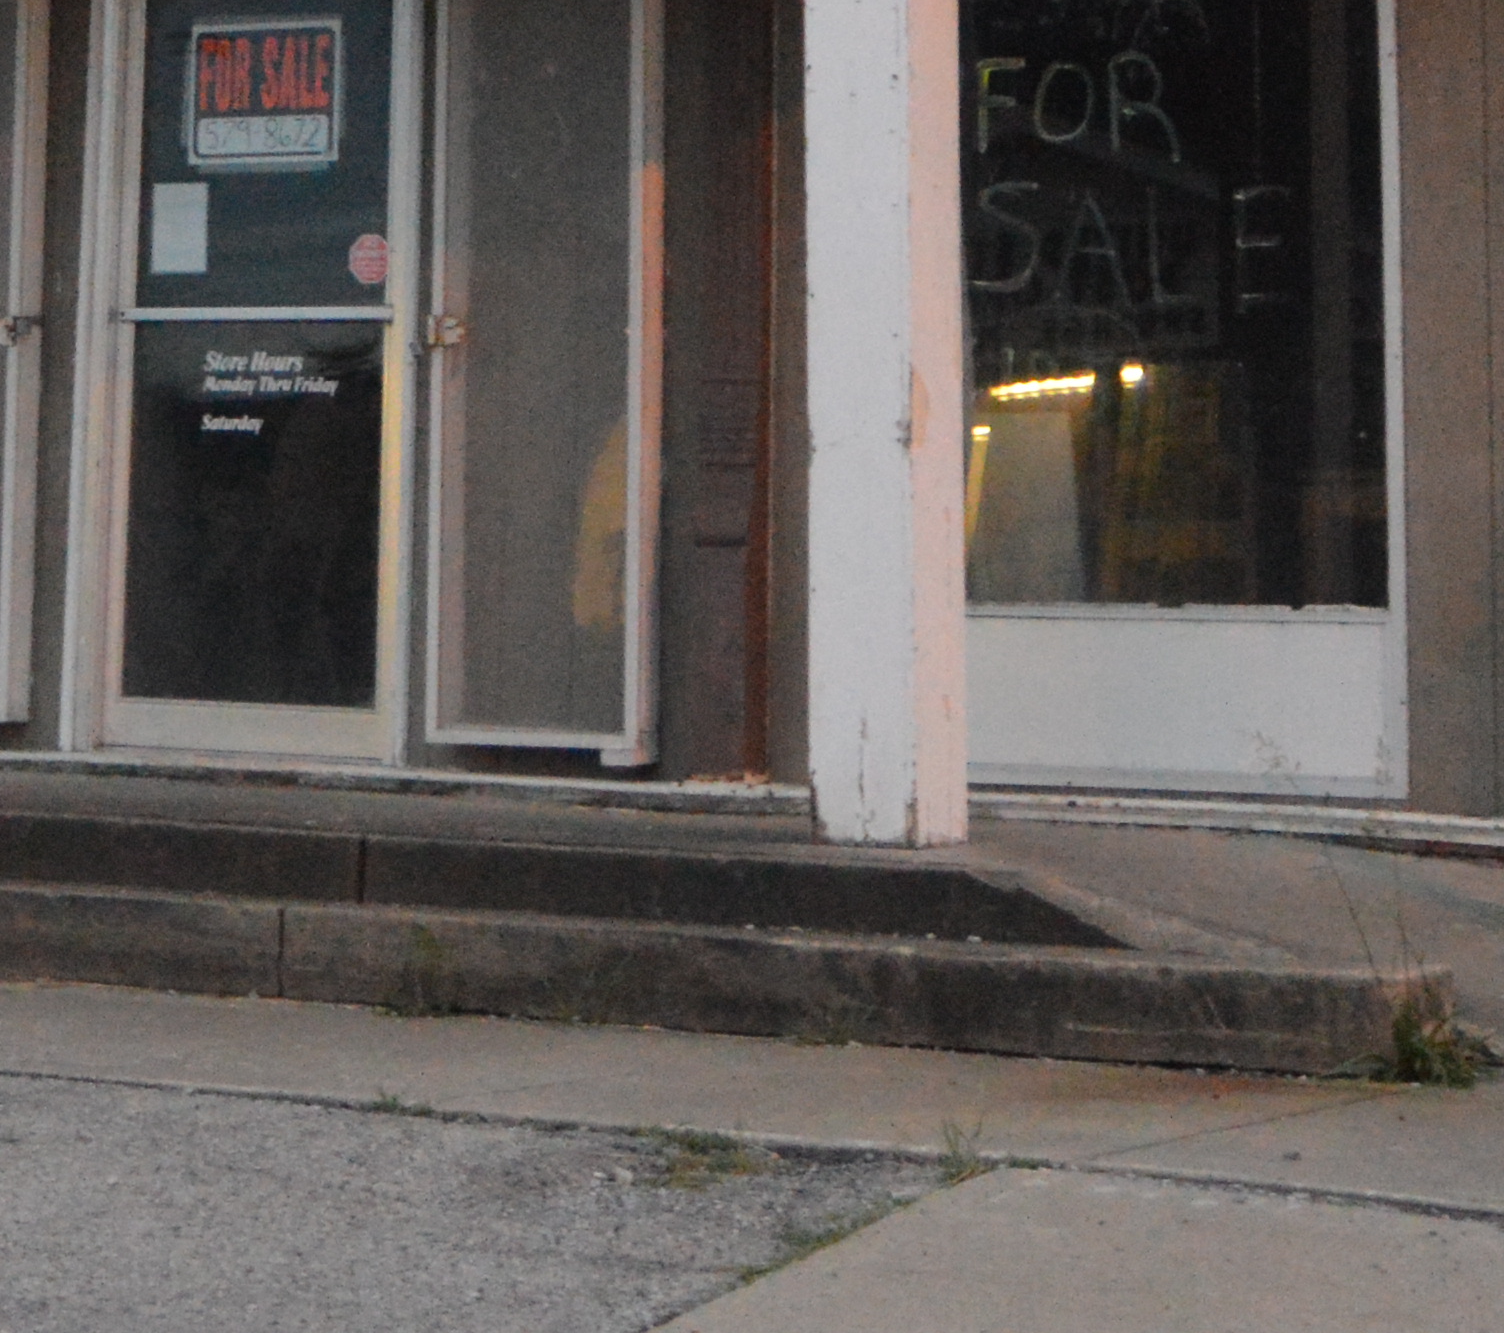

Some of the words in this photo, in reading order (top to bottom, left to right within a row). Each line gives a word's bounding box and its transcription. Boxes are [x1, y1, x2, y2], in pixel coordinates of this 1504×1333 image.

[199, 38, 251, 111] FOR
[261, 34, 330, 109] SALE
[976, 54, 1181, 163] FOR
[965, 181, 1290, 315] SALE
[203, 350, 249, 372] Store
[250, 351, 304, 372] Hours
[203, 375, 257, 396] Monday
[259, 376, 292, 393] Thru
[294, 376, 339, 397] Friday
[201, 414, 264, 436] Saturday
